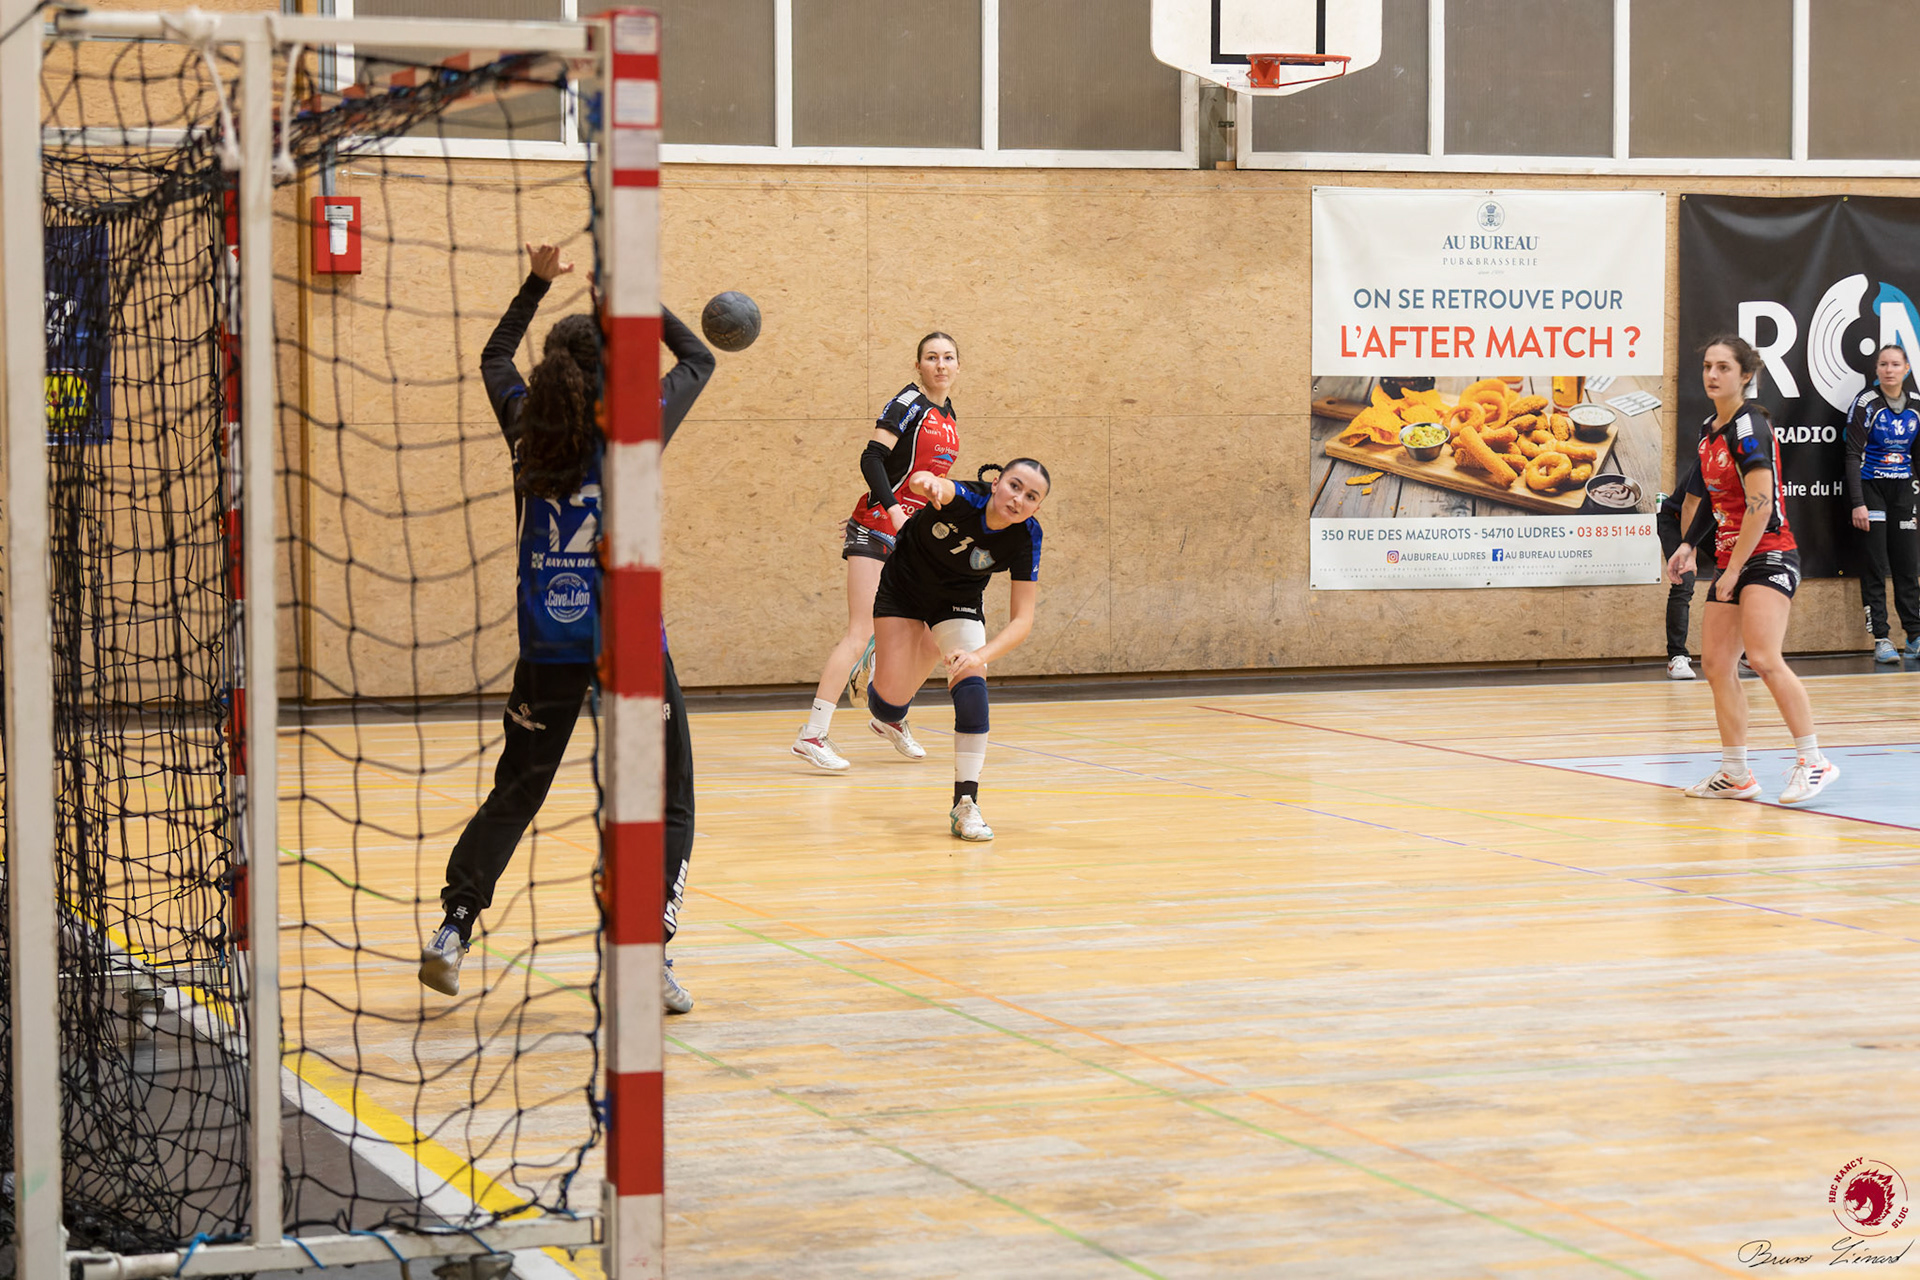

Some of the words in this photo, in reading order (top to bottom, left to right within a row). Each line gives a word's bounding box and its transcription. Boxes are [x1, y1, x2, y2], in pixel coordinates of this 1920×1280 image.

[1442, 235, 1466, 250] AU
[1469, 235, 1539, 251] BUREAU
[1443, 257, 1537, 266] PUB&BRASSERIE
[1353, 288, 1391, 309] ON
[1398, 288, 1424, 310] SE
[1432, 288, 1555, 310] RETROUVE
[1561, 289, 1623, 310] POUR
[1485, 325, 1613, 359] MATCH
[1623, 325, 1642, 358] ?
[942, 422, 956, 445] 11
[1774, 426, 1838, 444] RADIO
[1891, 419, 1906, 435] 16
[1781, 480, 1807, 497] aire
[1810, 480, 1830, 497] du
[1321, 529, 1344, 541] 350
[1348, 529, 1375, 541] RUE
[1378, 529, 1402, 541] DES
[1405, 528, 1471, 540] MAZUROTS
[1481, 527, 1514, 539] 54710
[1517, 526, 1566, 538] LUDRES
[1577, 526, 1593, 538] 03
[1595, 525, 1609, 538] 83
[1611, 525, 1622, 537] 51
[1625, 525, 1636, 537] 14
[1638, 524, 1652, 537] 68
[1400, 551, 1487, 562] AUBUREAU_LUDRES
[1505, 551, 1517, 559] AU
[1519, 550, 1556, 559] BUREAU
[1558, 550, 1593, 559] LUDRES
